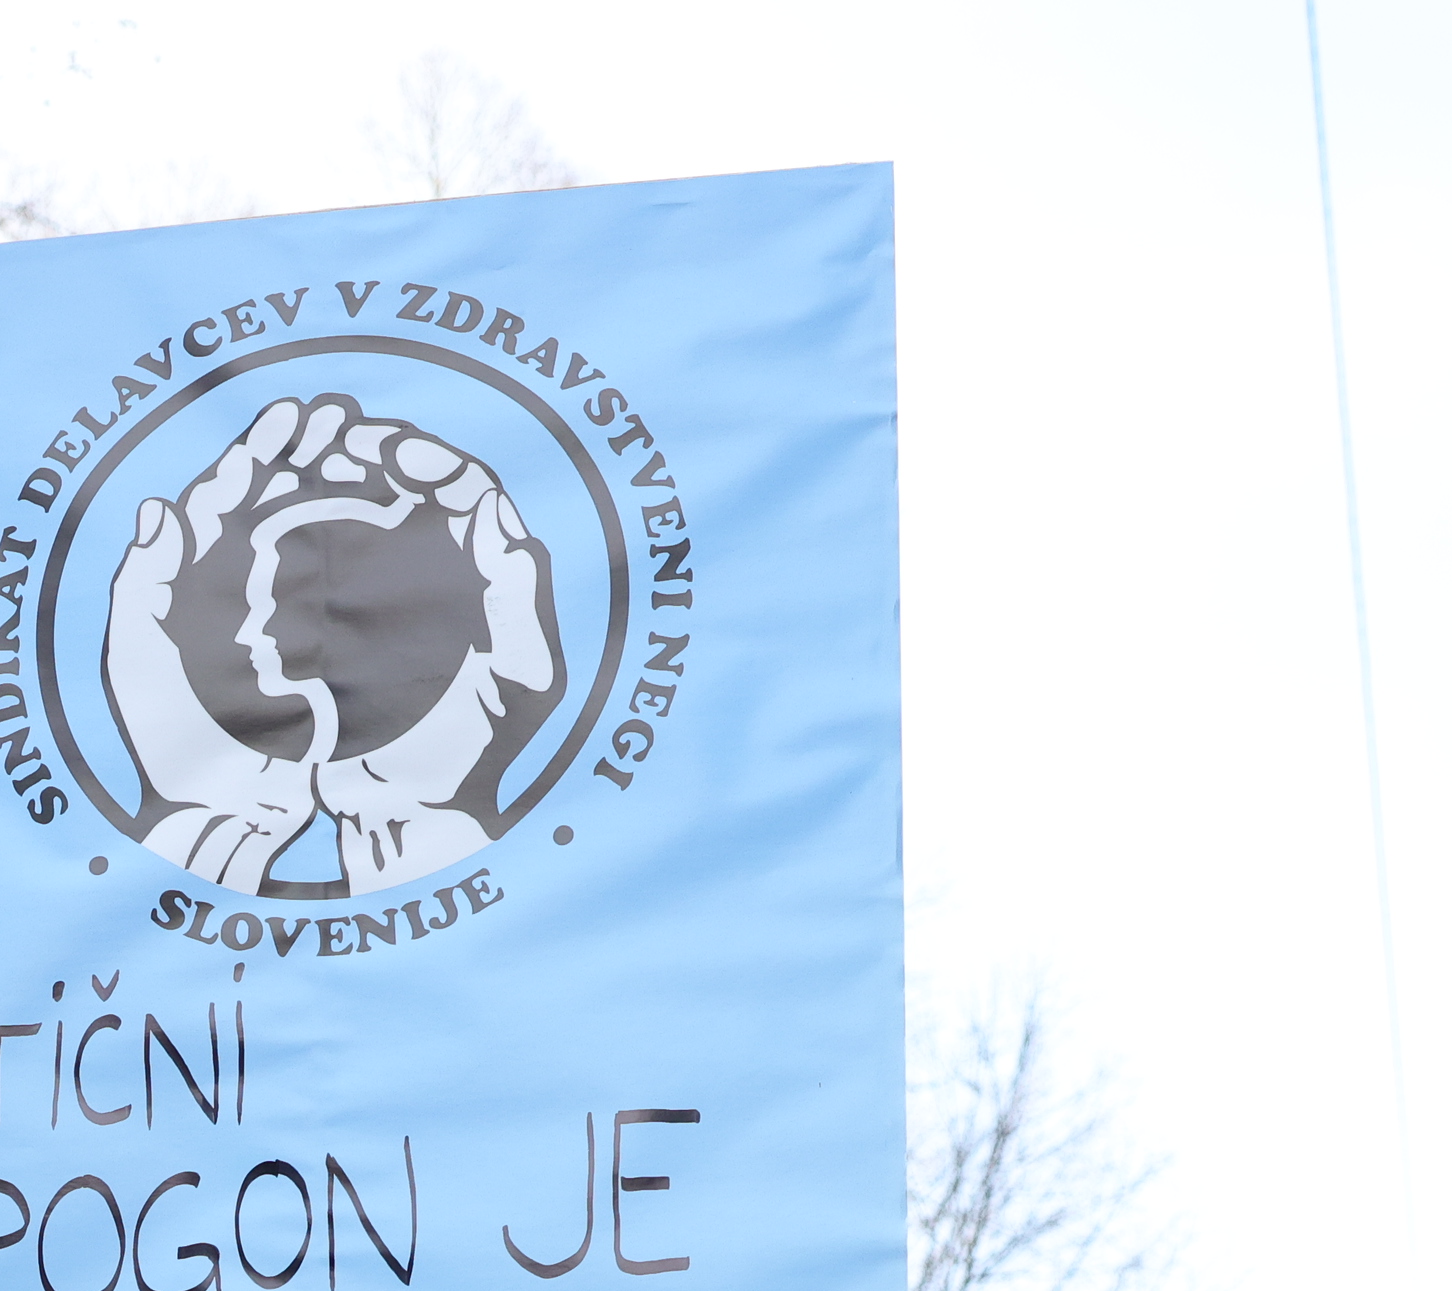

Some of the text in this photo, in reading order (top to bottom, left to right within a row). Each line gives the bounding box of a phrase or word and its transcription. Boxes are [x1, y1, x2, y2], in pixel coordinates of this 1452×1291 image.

[18, 287, 310, 515] DELAVCEV
[334, 280, 382, 318] V
[395, 282, 696, 611] ZDRAVSTVENI
[592, 630, 691, 791] NEGI
[149, 867, 505, 958] SLOVENIJE
[501, 1108, 702, 1279] JE
